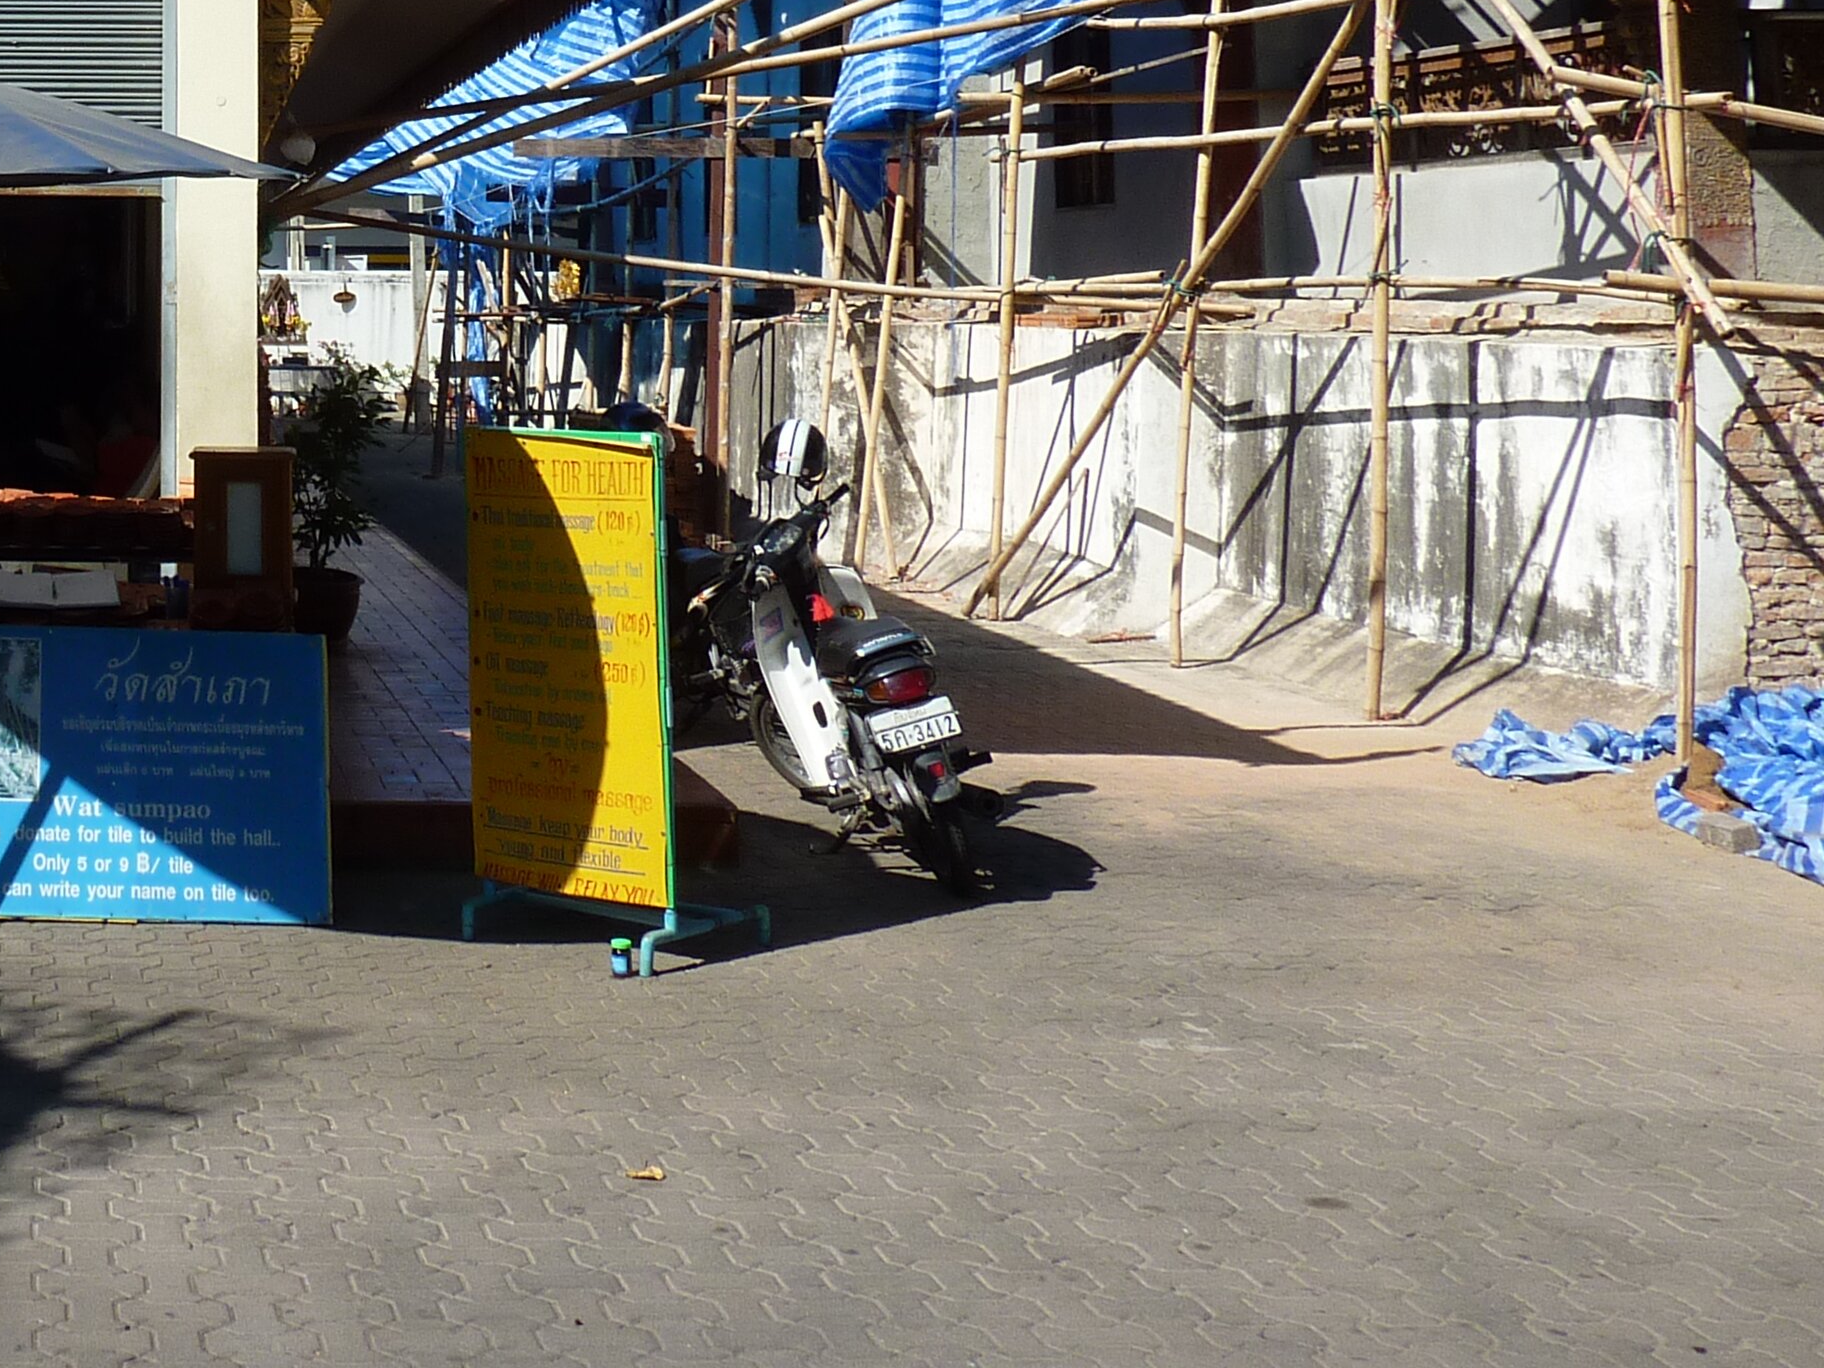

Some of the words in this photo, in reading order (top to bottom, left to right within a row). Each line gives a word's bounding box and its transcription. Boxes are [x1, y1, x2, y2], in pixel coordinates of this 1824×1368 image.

[472, 456, 545, 493] MASSAGE
[552, 460, 582, 495] FOR
[586, 460, 648, 497] HEALTH
[555, 514, 596, 533] massage
[93, 637, 272, 707] วัดสำเภา
[484, 700, 532, 727] Teaching
[537, 710, 584, 734] massage
[487, 773, 577, 802] professional
[583, 788, 654, 816] massage
[53, 795, 104, 818] Wat
[113, 800, 212, 823] sumpao
[15, 824, 71, 843] donate
[78, 824, 101, 843] for
[108, 824, 133, 844] tile
[139, 827, 157, 844] to
[164, 826, 204, 845] build
[210, 826, 237, 846] the
[539, 815, 571, 836] keep
[574, 822, 605, 839] your
[609, 825, 644, 847] body
[33, 853, 71, 875] Only
[76, 855, 88, 873] 5
[94, 859, 115, 873] or
[119, 856, 129, 873] 9
[168, 856, 194, 874] tile
[540, 844, 566, 862] and
[573, 844, 622, 870] flexible
[3, 882, 32, 898] can
[39, 880, 80, 899] write
[87, 882, 123, 902] your
[131, 884, 177, 901] name
[183, 885, 204, 902] on
[211, 884, 236, 902] tile
[243, 885, 274, 903] too.
[574, 878, 619, 900] RELAX
